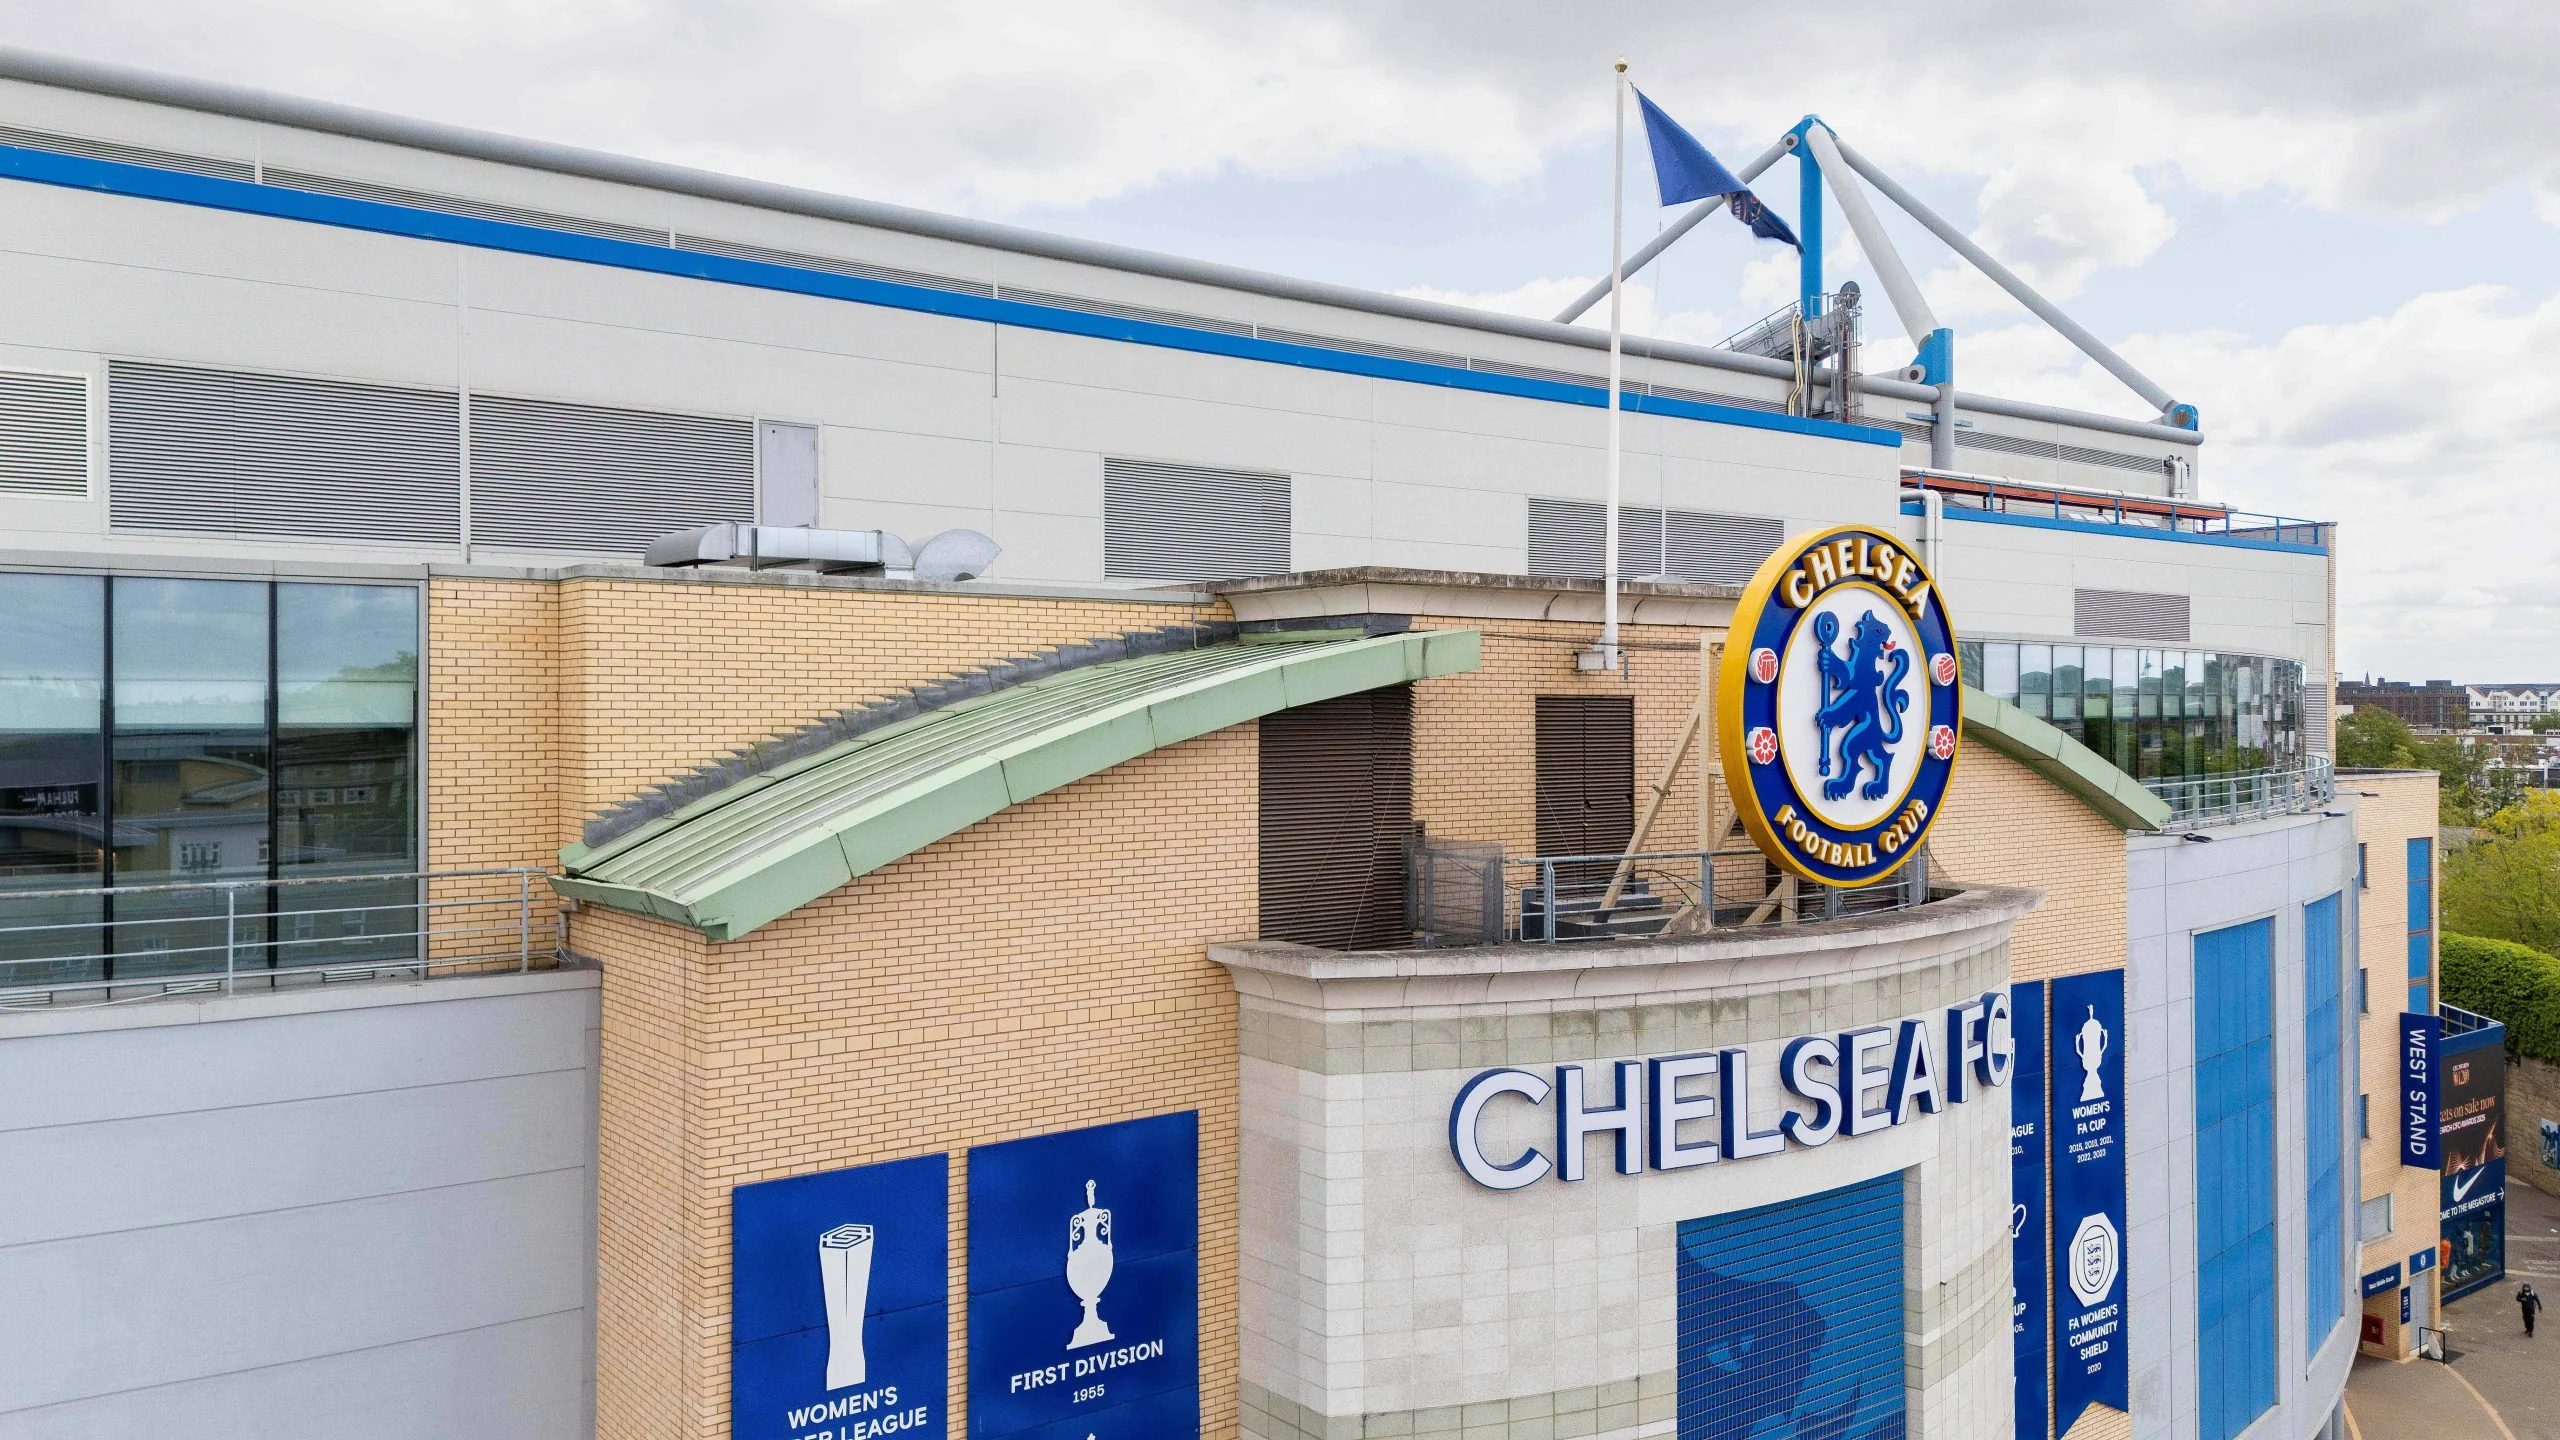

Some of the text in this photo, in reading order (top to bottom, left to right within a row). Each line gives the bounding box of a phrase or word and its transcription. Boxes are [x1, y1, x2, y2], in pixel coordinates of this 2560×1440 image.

[1782, 537, 1931, 619] CHELSEA
[1775, 799, 1929, 868] FOOTBALL CLUB
[1448, 991, 2009, 1191] CHELSEA FC
[2409, 1029, 2427, 1155] WEST STAND
[2071, 1100, 2110, 1120] WOMEN'S
[2453, 1105, 2464, 1118] on
[2464, 1097, 2479, 1115] sale
[2480, 1096, 2496, 1110] now
[2011, 1123, 2034, 1139] AGUE
[2077, 1118, 2106, 1135] FA CUP
[2011, 1145, 2024, 1156] 010,
[2450, 1206, 2458, 1217] TO
[2458, 1202, 2468, 1214] THE
[2468, 1192, 2496, 1210] MEGASTORE
[2013, 1302, 2027, 1317] UP
[2068, 1304, 2118, 1331] FA WOMEN'S
[2069, 1319, 2118, 1348] COMMUNITY
[2080, 1340, 2109, 1361] SHIELD
[1011, 1338, 1164, 1394] FIRST DIVISION
[1072, 1384, 1105, 1403] 1955
[787, 1386, 898, 1430] WOMEN'S
[840, 1406, 928, 1440] LEAGUE
